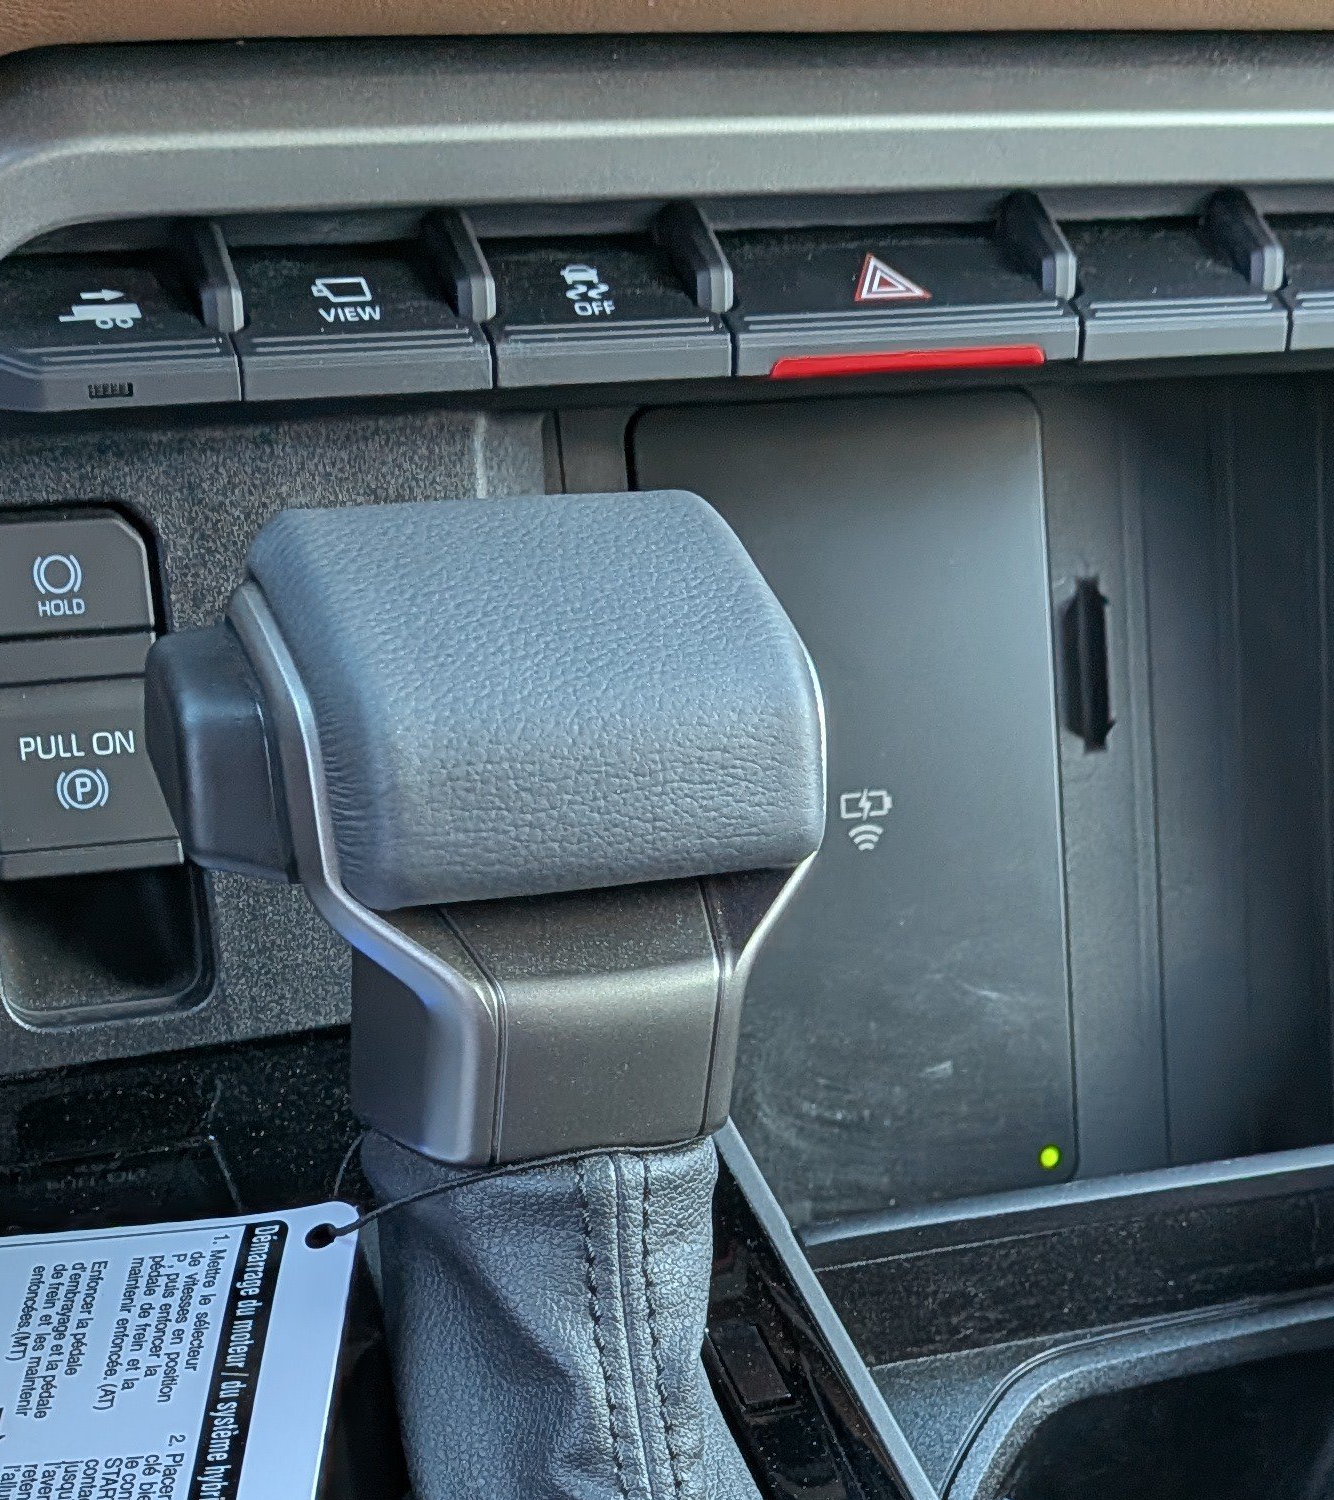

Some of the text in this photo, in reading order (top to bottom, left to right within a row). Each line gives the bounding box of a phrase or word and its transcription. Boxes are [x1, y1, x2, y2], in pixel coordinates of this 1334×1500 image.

[318, 304, 381, 323] VIEW
[573, 300, 616, 316] OFF
[38, 598, 86, 618] HOLD
[19, 729, 136, 762] PULL ON
[235, 1223, 280, 1296] Démarrage
[63, 1259, 109, 1376] Enfoncer la pédale
[119, 1253, 166, 1391] pédale de frein et la
[142, 1251, 188, 1378] P, puis enfoncer la
[183, 1233, 231, 1372] 1. Mettre le sélecteur
[234, 1298, 263, 1317] du
[14, 1262, 69, 1417] de frein et les maintenir
[47, 1342, 65, 1357] et
[91, 1255, 145, 1411] maintenir enfoncée. (AT)
[156, 1250, 206, 1403] de vitesses en position
[224, 1318, 255, 1368] moteur
[44, 1358, 64, 1372] la
[32, 1373, 58, 1419] pédale
[218, 1379, 247, 1399] du
[166, 1433, 187, 1447] 2.
[205, 1400, 239, 1462] système
[123, 1454, 144, 1470] le
[140, 1453, 162, 1477] clé
[156, 1451, 184, 1500] Placer
